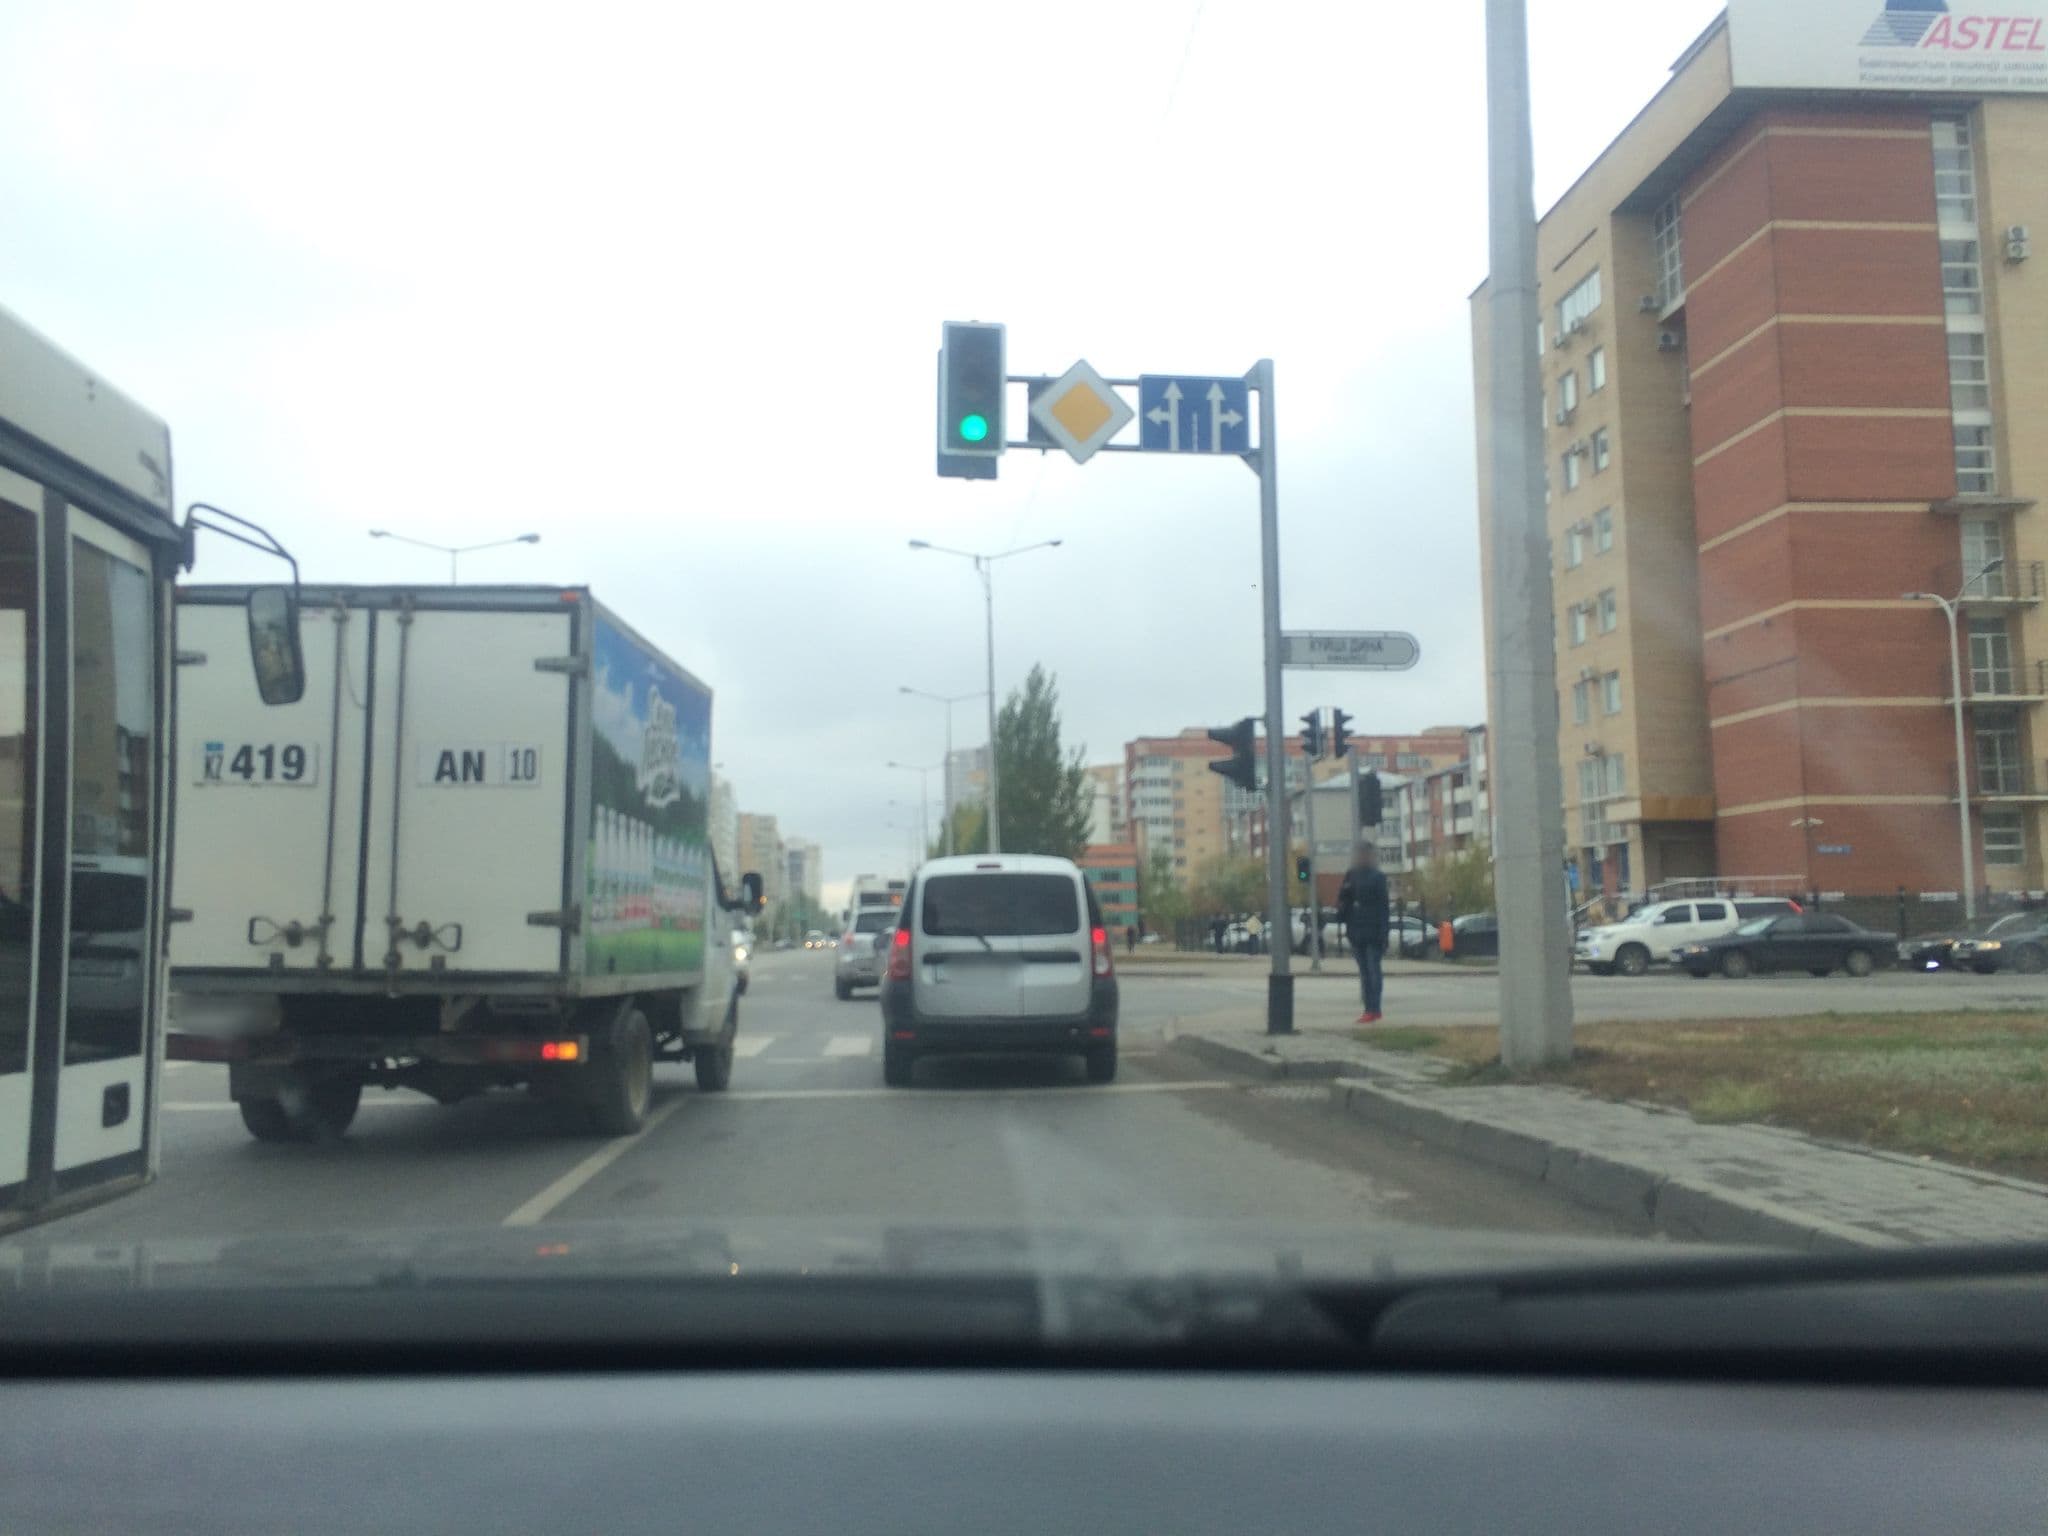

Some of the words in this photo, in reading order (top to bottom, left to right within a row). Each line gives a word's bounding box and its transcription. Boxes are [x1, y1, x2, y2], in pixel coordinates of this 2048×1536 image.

[1922, 15, 2046, 50] ASTEL
[230, 744, 307, 781] 419
[434, 749, 486, 783] AN
[510, 748, 538, 781] 10
